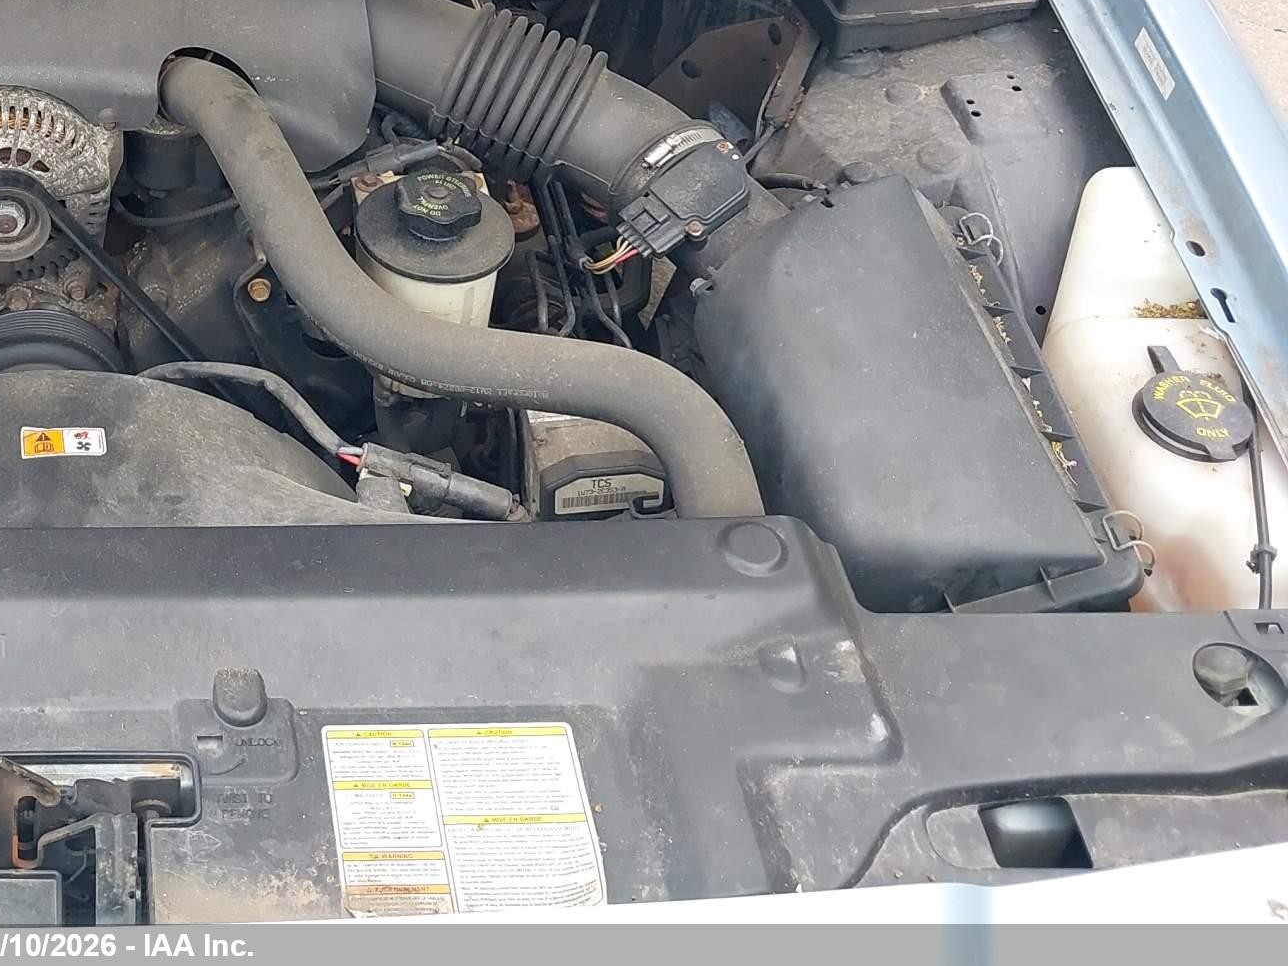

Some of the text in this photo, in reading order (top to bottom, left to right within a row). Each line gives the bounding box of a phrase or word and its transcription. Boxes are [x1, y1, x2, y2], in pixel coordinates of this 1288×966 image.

[416, 174, 473, 198] POWER STEERING
[413, 204, 429, 214] NOT
[1152, 375, 1238, 404] WASHER FLUID
[1196, 427, 1231, 439] ONLY
[591, 478, 613, 489] TCS
[234, 737, 281, 747] UNLOCK
[256, 792, 273, 804] TO
